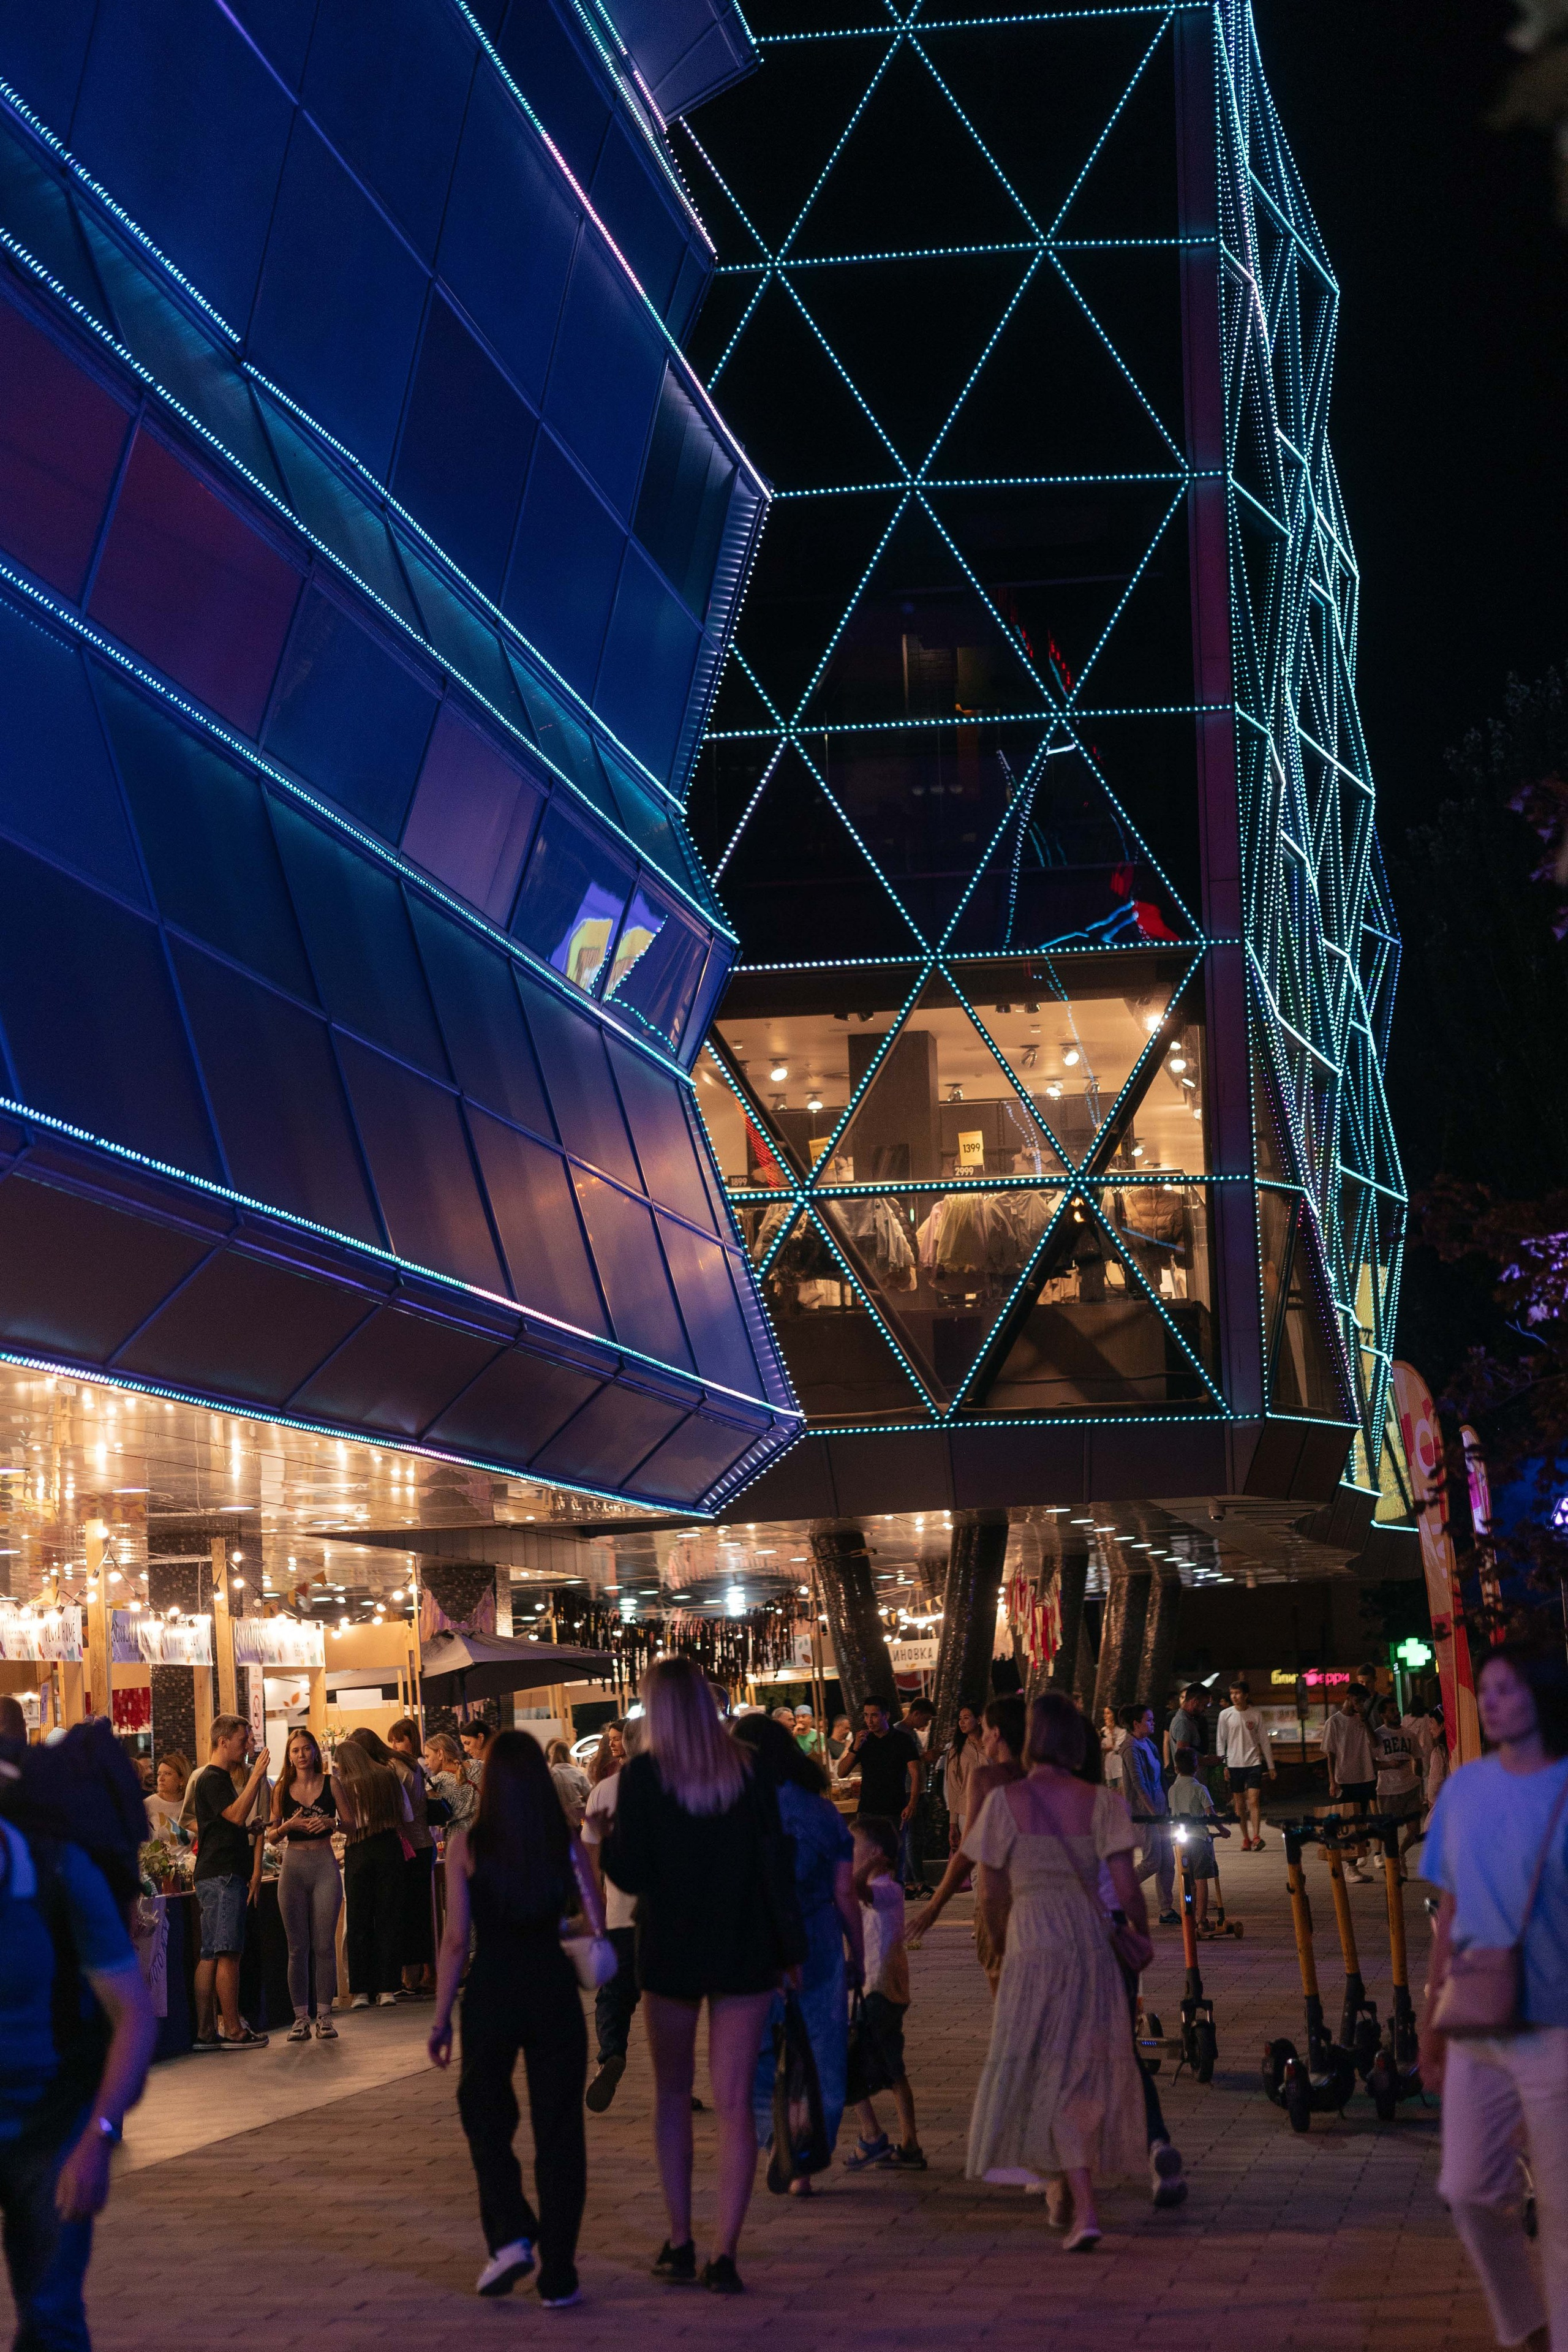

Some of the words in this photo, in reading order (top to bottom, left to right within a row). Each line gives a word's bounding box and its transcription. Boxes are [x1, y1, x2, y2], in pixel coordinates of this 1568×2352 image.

[962, 1143, 981, 1153] 1399
[954, 1166, 974, 1176] 2999
[730, 1177, 748, 1187] 1899
